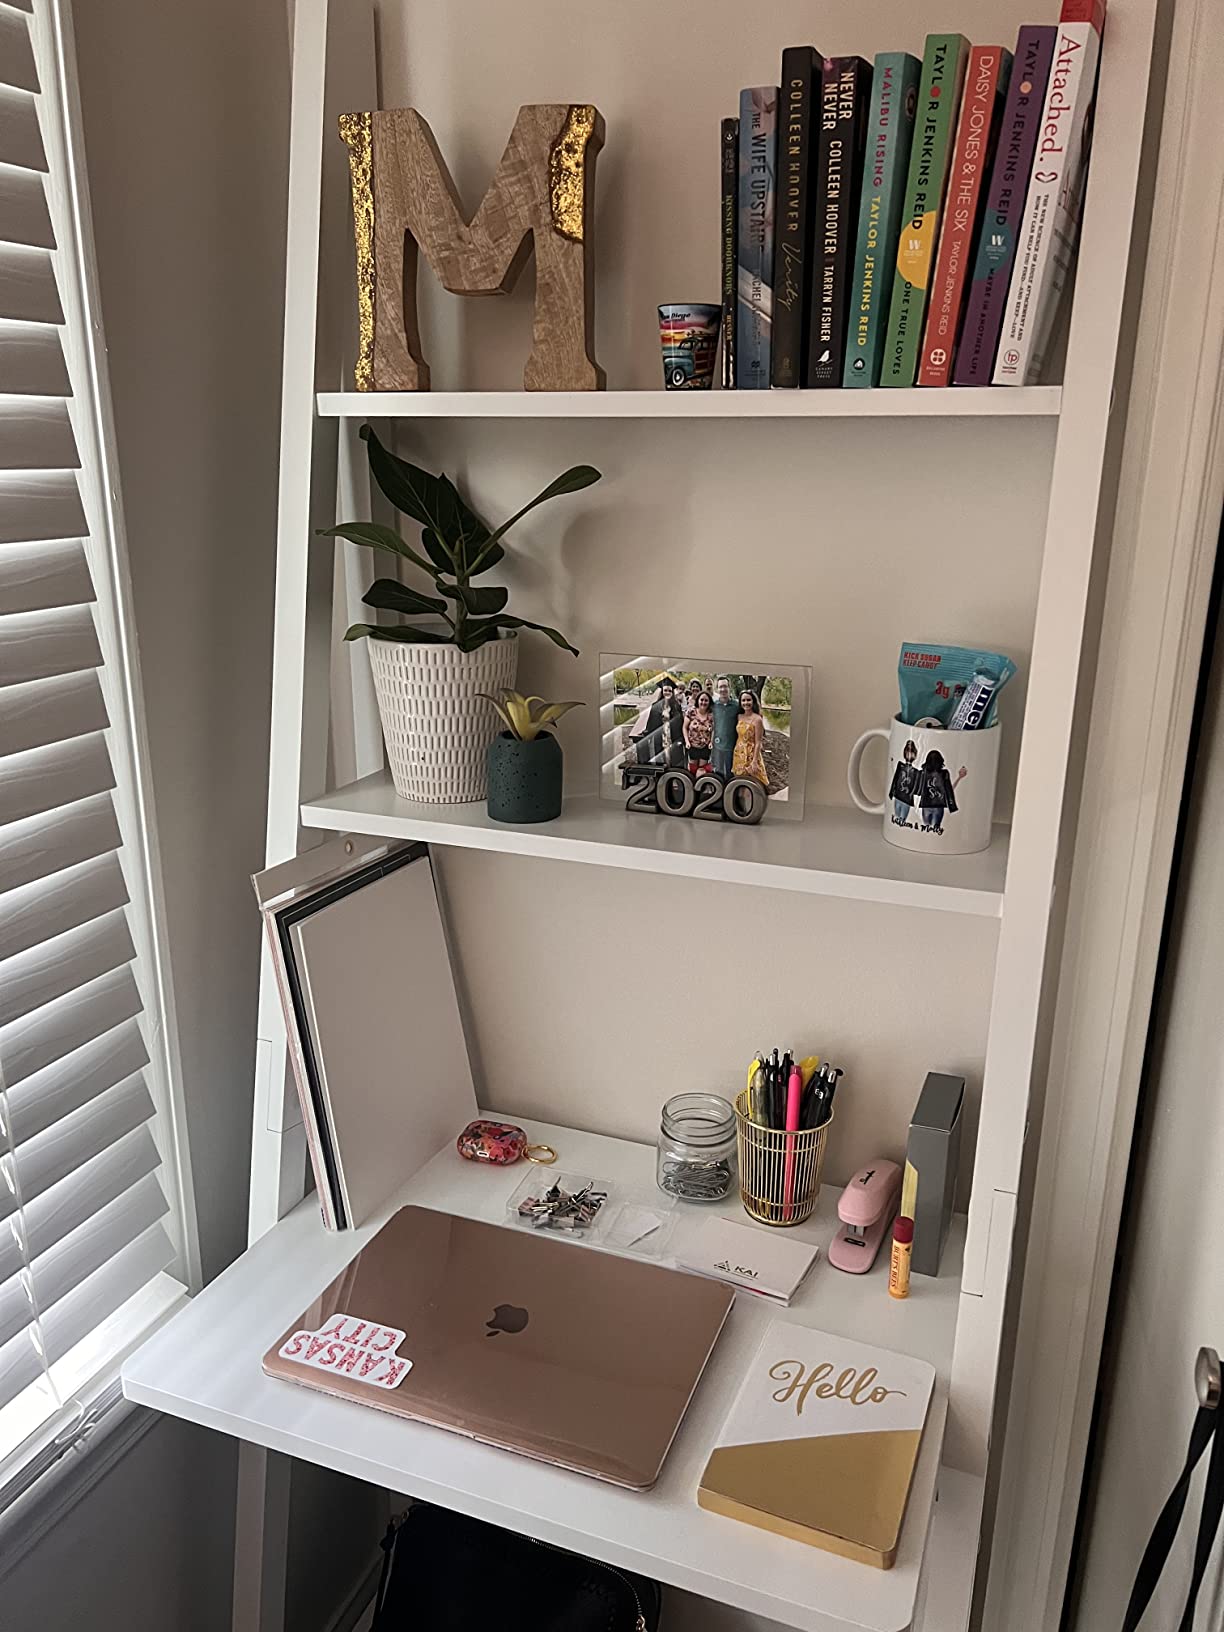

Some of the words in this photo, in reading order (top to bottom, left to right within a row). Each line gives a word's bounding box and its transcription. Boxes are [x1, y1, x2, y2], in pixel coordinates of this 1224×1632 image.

[839, 72, 854, 120] NEVER
[880, 67, 893, 127] MALIBU
[976, 56, 994, 102] DAISY
[1040, 34, 1082, 162] Attached.
[752, 112, 761, 129] THE
[789, 79, 803, 155] COLLEEN
[823, 83, 838, 130] NEVER
[751, 132, 766, 174] WIFE
[919, 117, 937, 186] JENKINS
[966, 105, 985, 159] JONES
[1004, 113, 1026, 182] JENKINS
[827, 140, 842, 199] COLLEEN
[874, 134, 887, 187] RISING
[963, 164, 976, 175] &
[788, 163, 800, 231] HOOVER
[913, 192, 926, 229] REID
[958, 177, 973, 205] THE
[997, 188, 1012, 226] REID
[825, 204, 839, 254] HOOVER
[868, 195, 881, 249] TAYLOR
[953, 209, 969, 232] SIX
[338, 104, 606, 392] M
[950, 240, 962, 274] TAYLOR
[823, 265, 835, 303] TARRYN
[861, 254, 875, 311] JENKINS
[904, 281, 912, 305] ONE
[942, 275, 957, 313] JENKINS
[821, 306, 832, 342] FISHER
[858, 316, 869, 346] REID
[898, 309, 909, 336] TRUE
[939, 315, 949, 336] REID
[893, 340, 905, 375] LOVES
[626, 767, 768, 825] 2020
[321, 1318, 397, 1352] CITY
[285, 1334, 405, 1386] KANSAS
[768, 1359, 907, 1416] Hello
